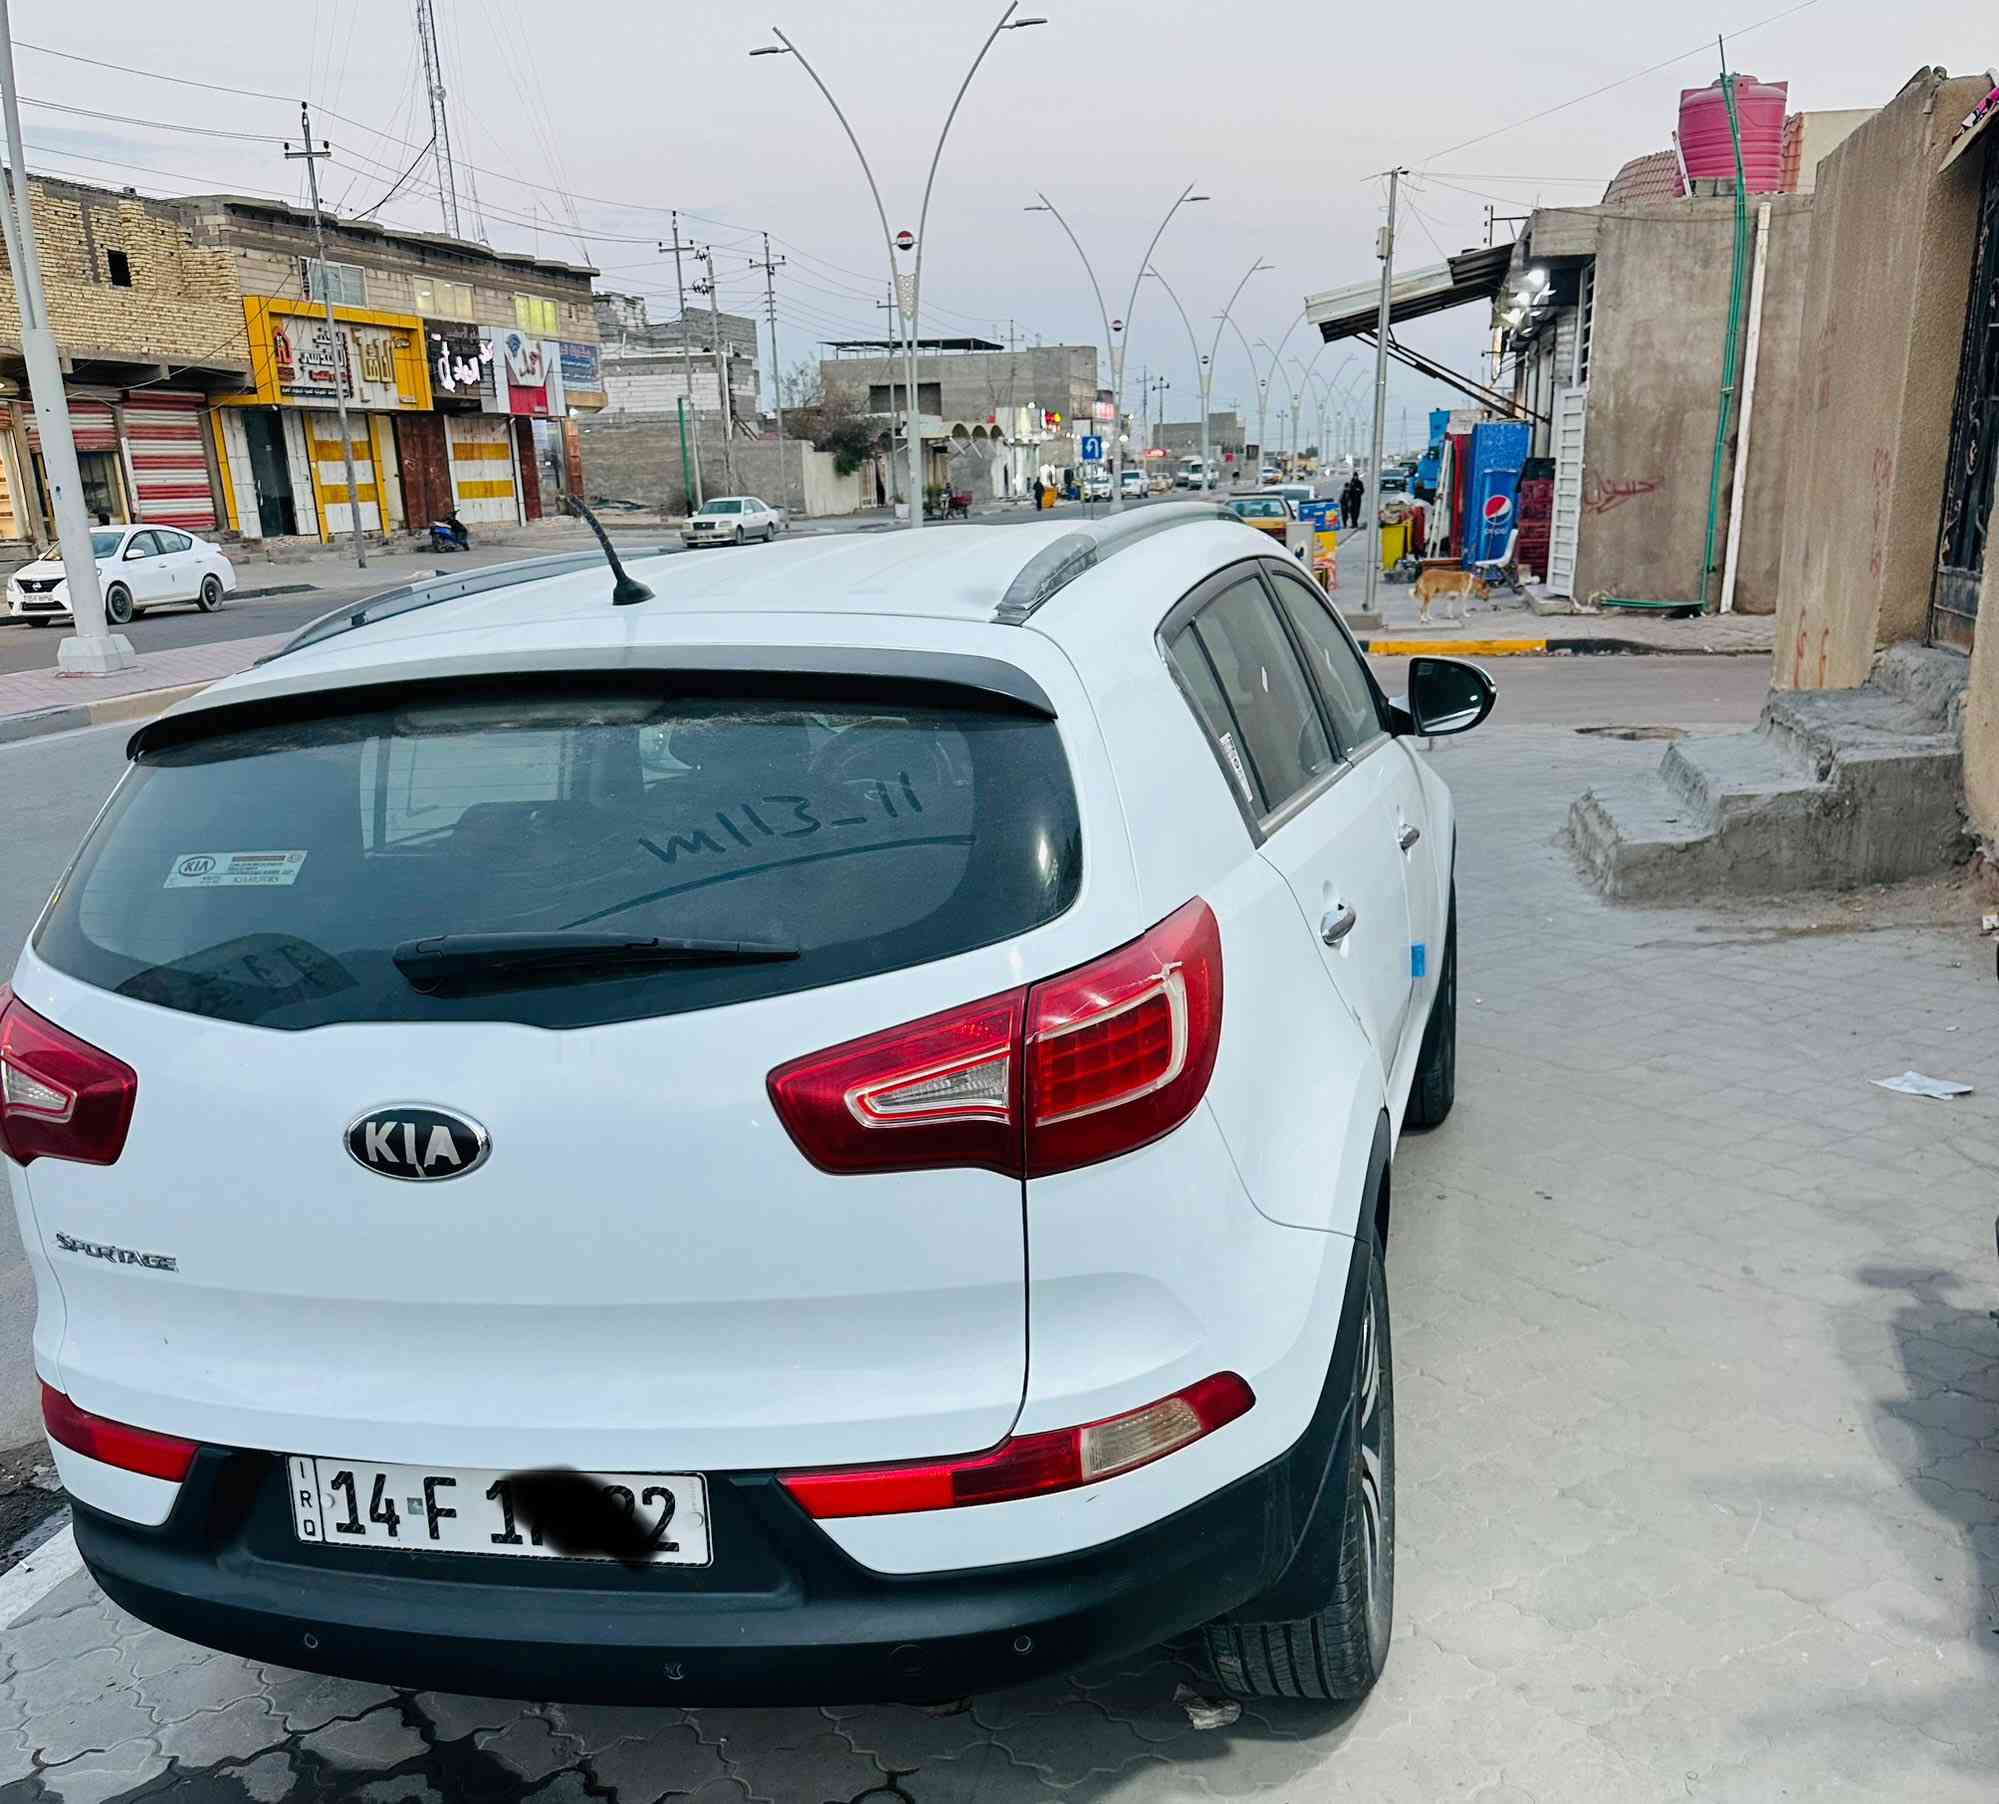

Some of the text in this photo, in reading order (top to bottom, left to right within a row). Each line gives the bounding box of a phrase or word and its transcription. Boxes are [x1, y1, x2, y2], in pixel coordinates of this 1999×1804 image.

[365, 1121, 462, 1172] KIA
[56, 1231, 178, 1272] SPORTAGE
[330, 1470, 401, 1537] 14
[423, 1476, 457, 1540] F
